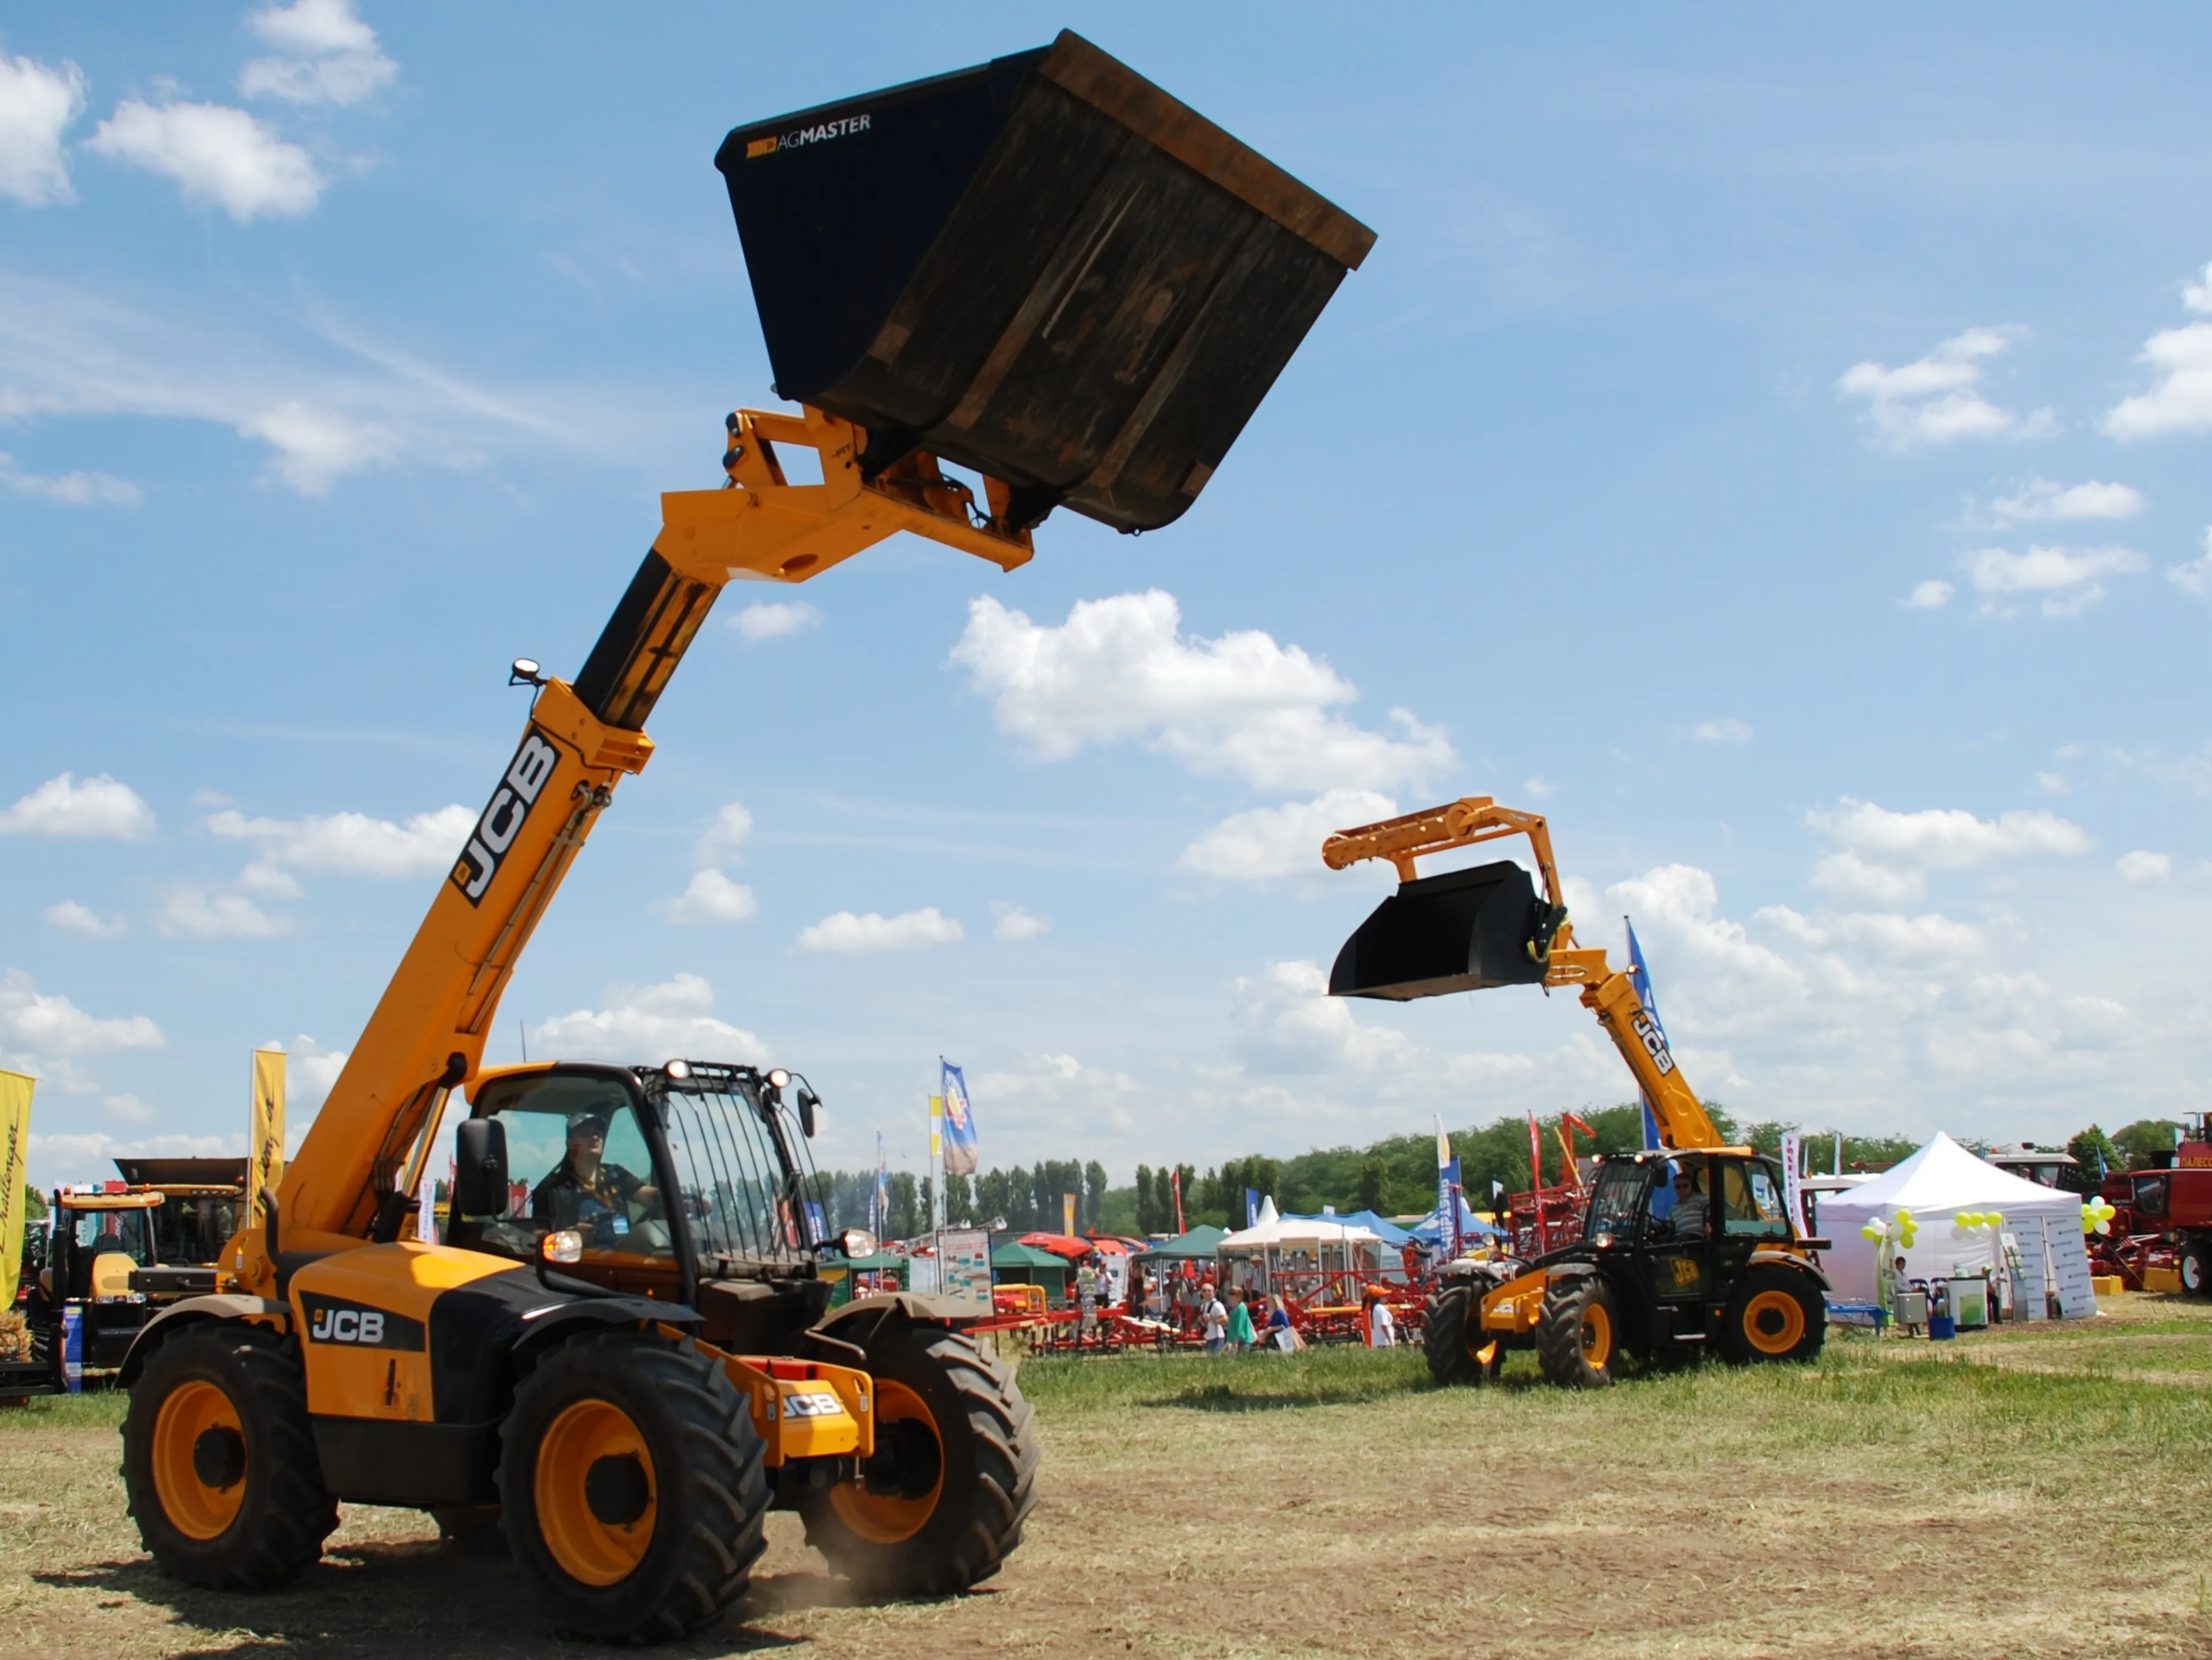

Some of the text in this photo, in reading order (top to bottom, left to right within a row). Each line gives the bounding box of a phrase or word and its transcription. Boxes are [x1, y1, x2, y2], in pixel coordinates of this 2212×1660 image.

[778, 115, 871, 151] AGMASTER
[465, 735, 556, 898] JCB
[1633, 1019, 1673, 1075] JCB
[1675, 1261, 1697, 1283] JCB
[313, 1309, 385, 1343] JCB
[783, 1393, 842, 1417] JCB
